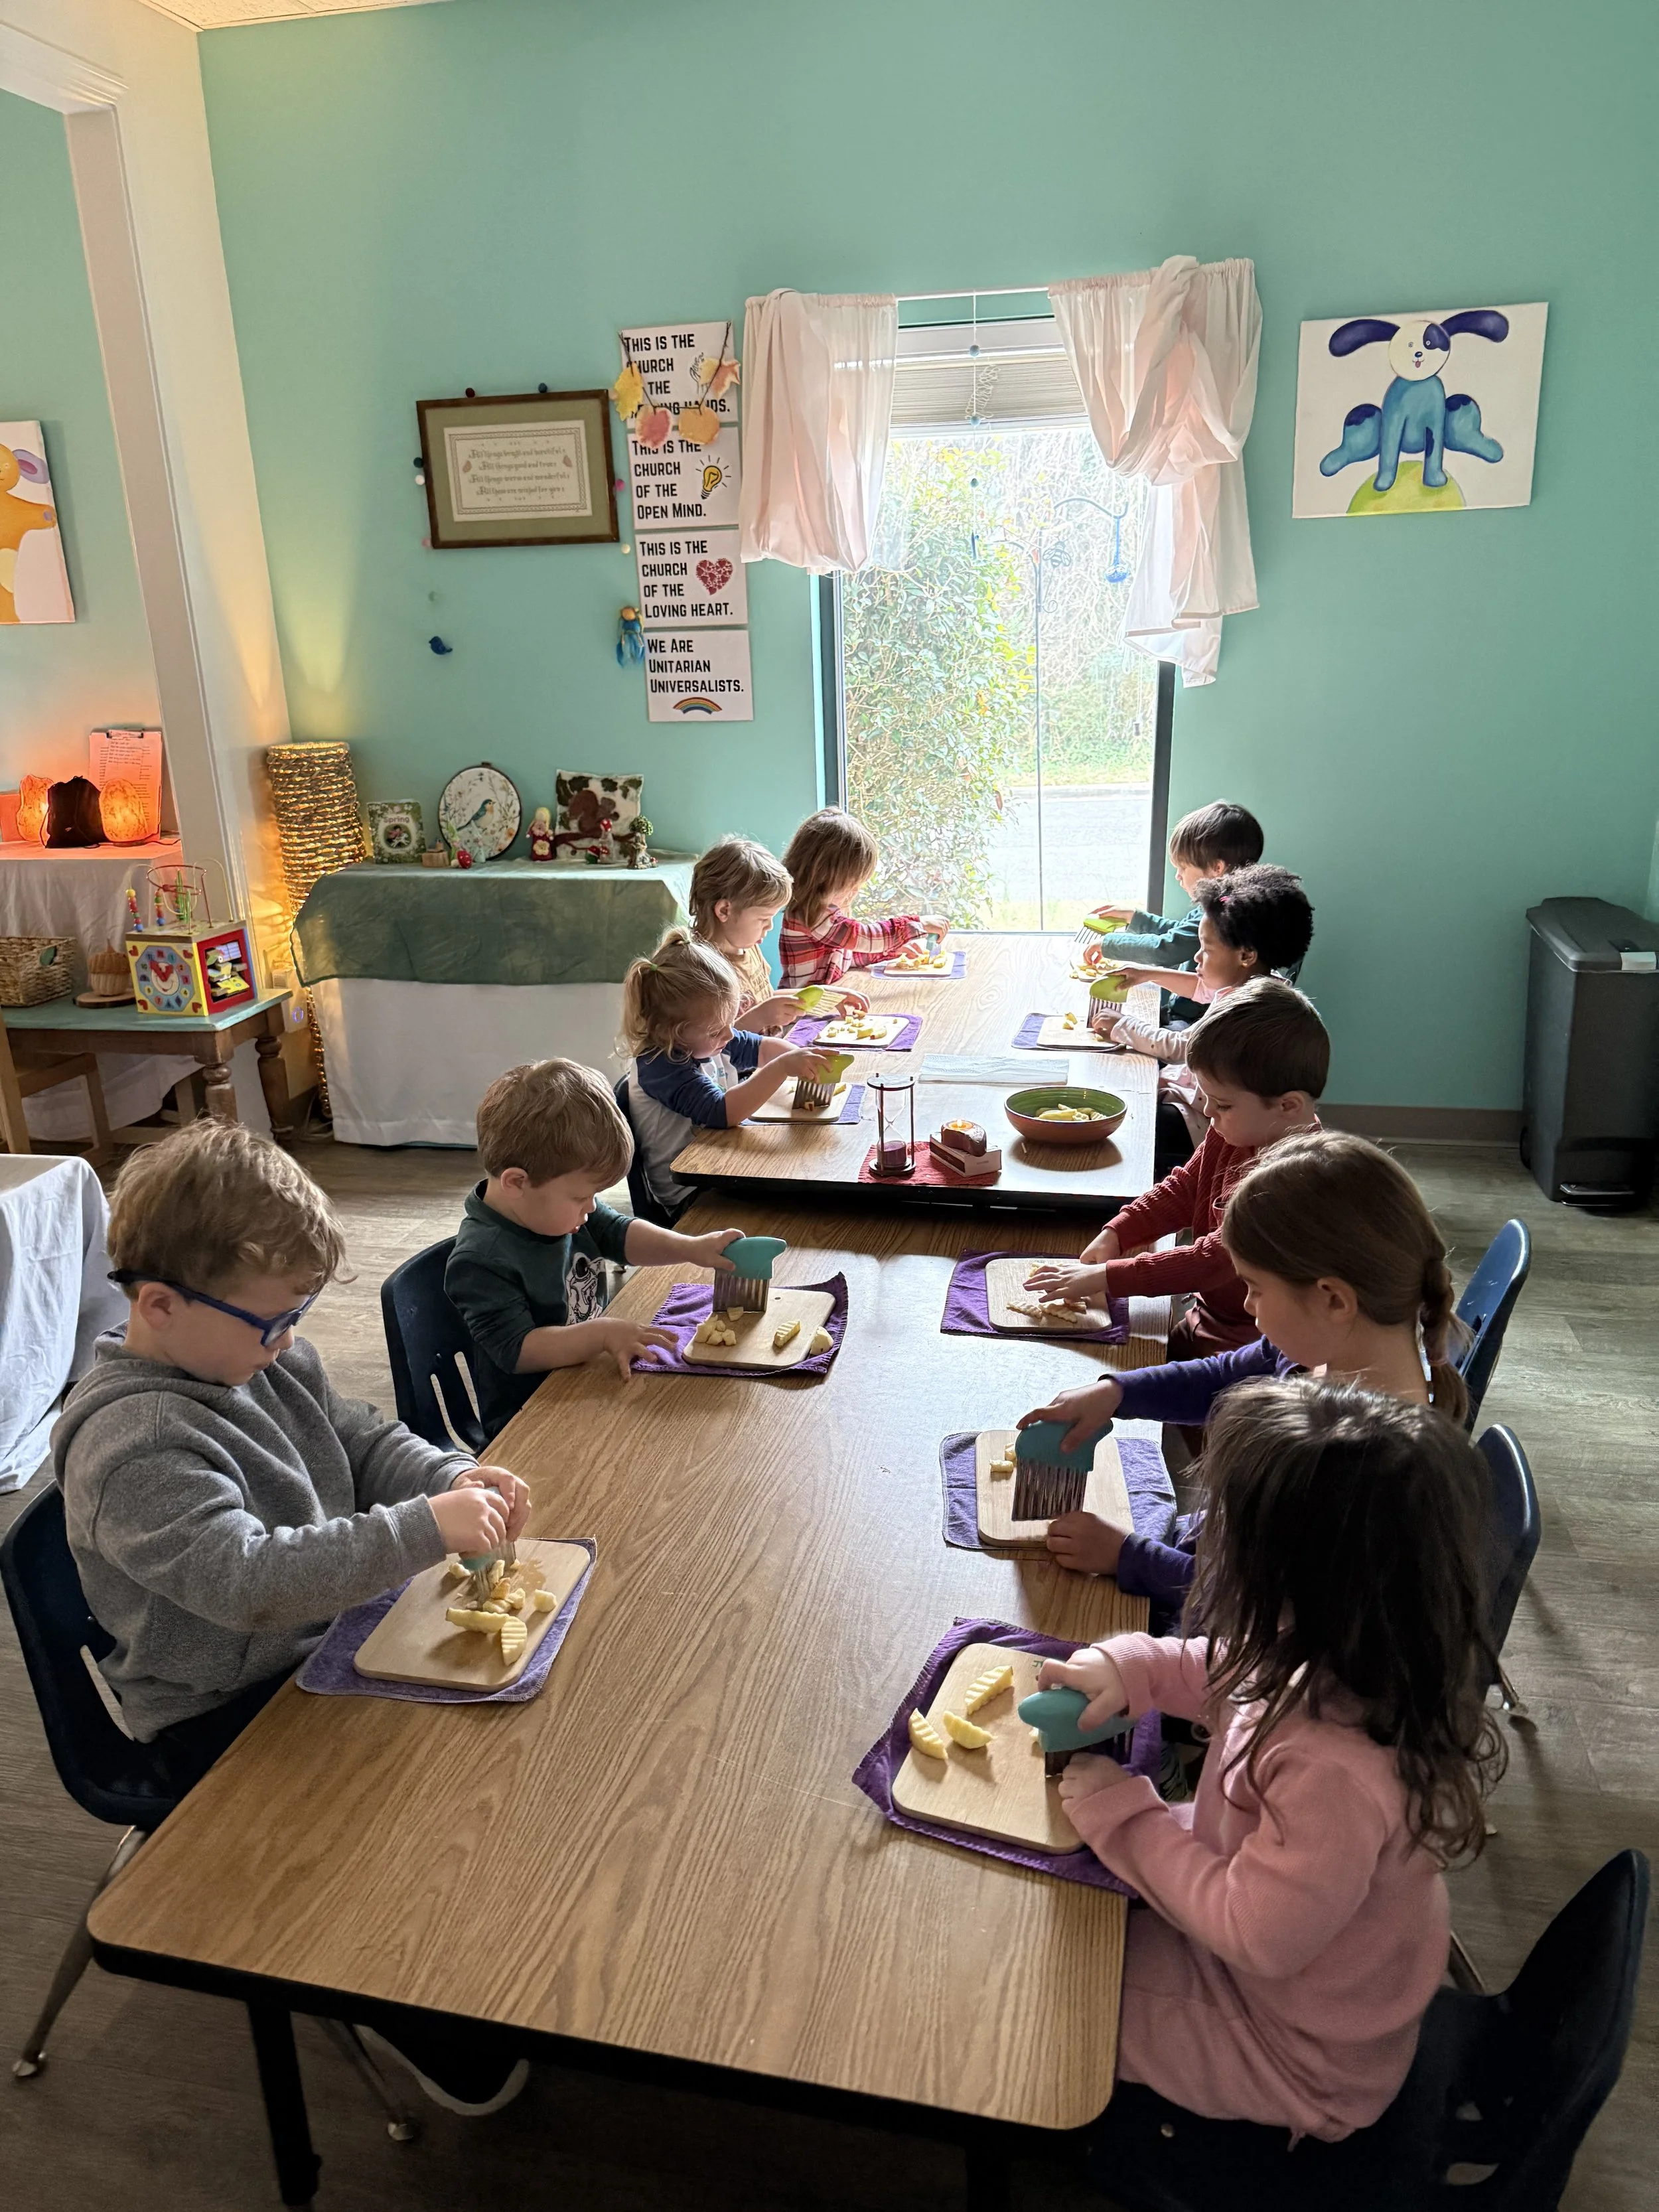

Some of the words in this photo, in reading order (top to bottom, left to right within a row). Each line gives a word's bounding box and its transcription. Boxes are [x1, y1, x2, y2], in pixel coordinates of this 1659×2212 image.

[624, 337, 651, 352] THIS
[656, 336, 667, 350] IS
[672, 334, 695, 348] THE
[648, 380, 670, 395] THE
[664, 440, 674, 454] IS
[634, 462, 680, 477] CHURCH
[636, 485, 650, 498] OF
[655, 484, 677, 497] THE
[638, 505, 668, 519] OPEN
[673, 503, 706, 518] MIND.
[640, 542, 666, 555] THIS
[670, 542, 680, 555] IS
[685, 540, 707, 553] THE
[642, 563, 687, 577] CHURCH
[644, 585, 658, 597] OF
[662, 584, 684, 597] THE
[645, 604, 686, 618] LOVING
[691, 603, 733, 617] HEART.
[648, 639, 666, 653] WE
[671, 638, 693, 652] ARE
[649, 659, 710, 673] UNITARIAN
[650, 680, 743, 693] UNIVERSALISTS.
